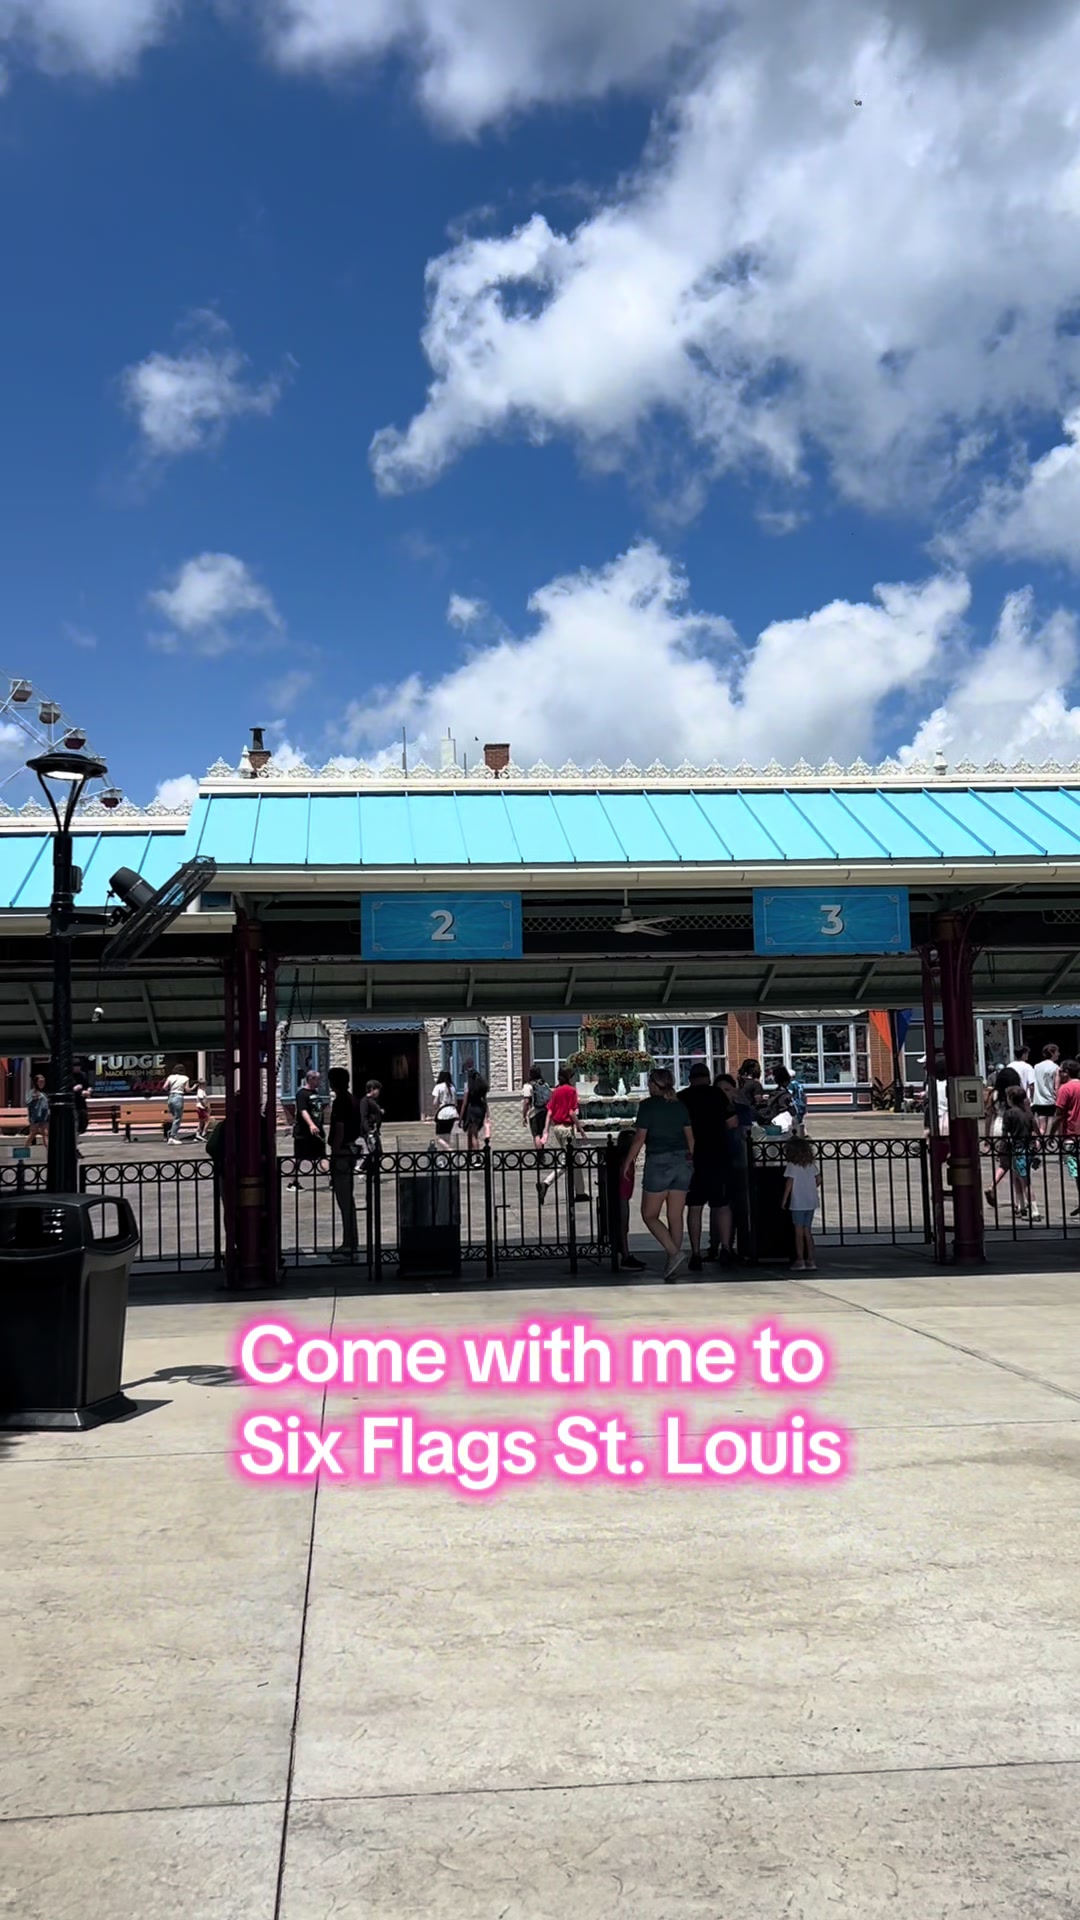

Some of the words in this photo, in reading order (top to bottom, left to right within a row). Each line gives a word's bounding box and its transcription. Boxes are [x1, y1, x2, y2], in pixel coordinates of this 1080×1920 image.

[430, 910, 455, 940] 2
[820, 905, 843, 936] 3
[88, 1054, 166, 1076] FUDGE
